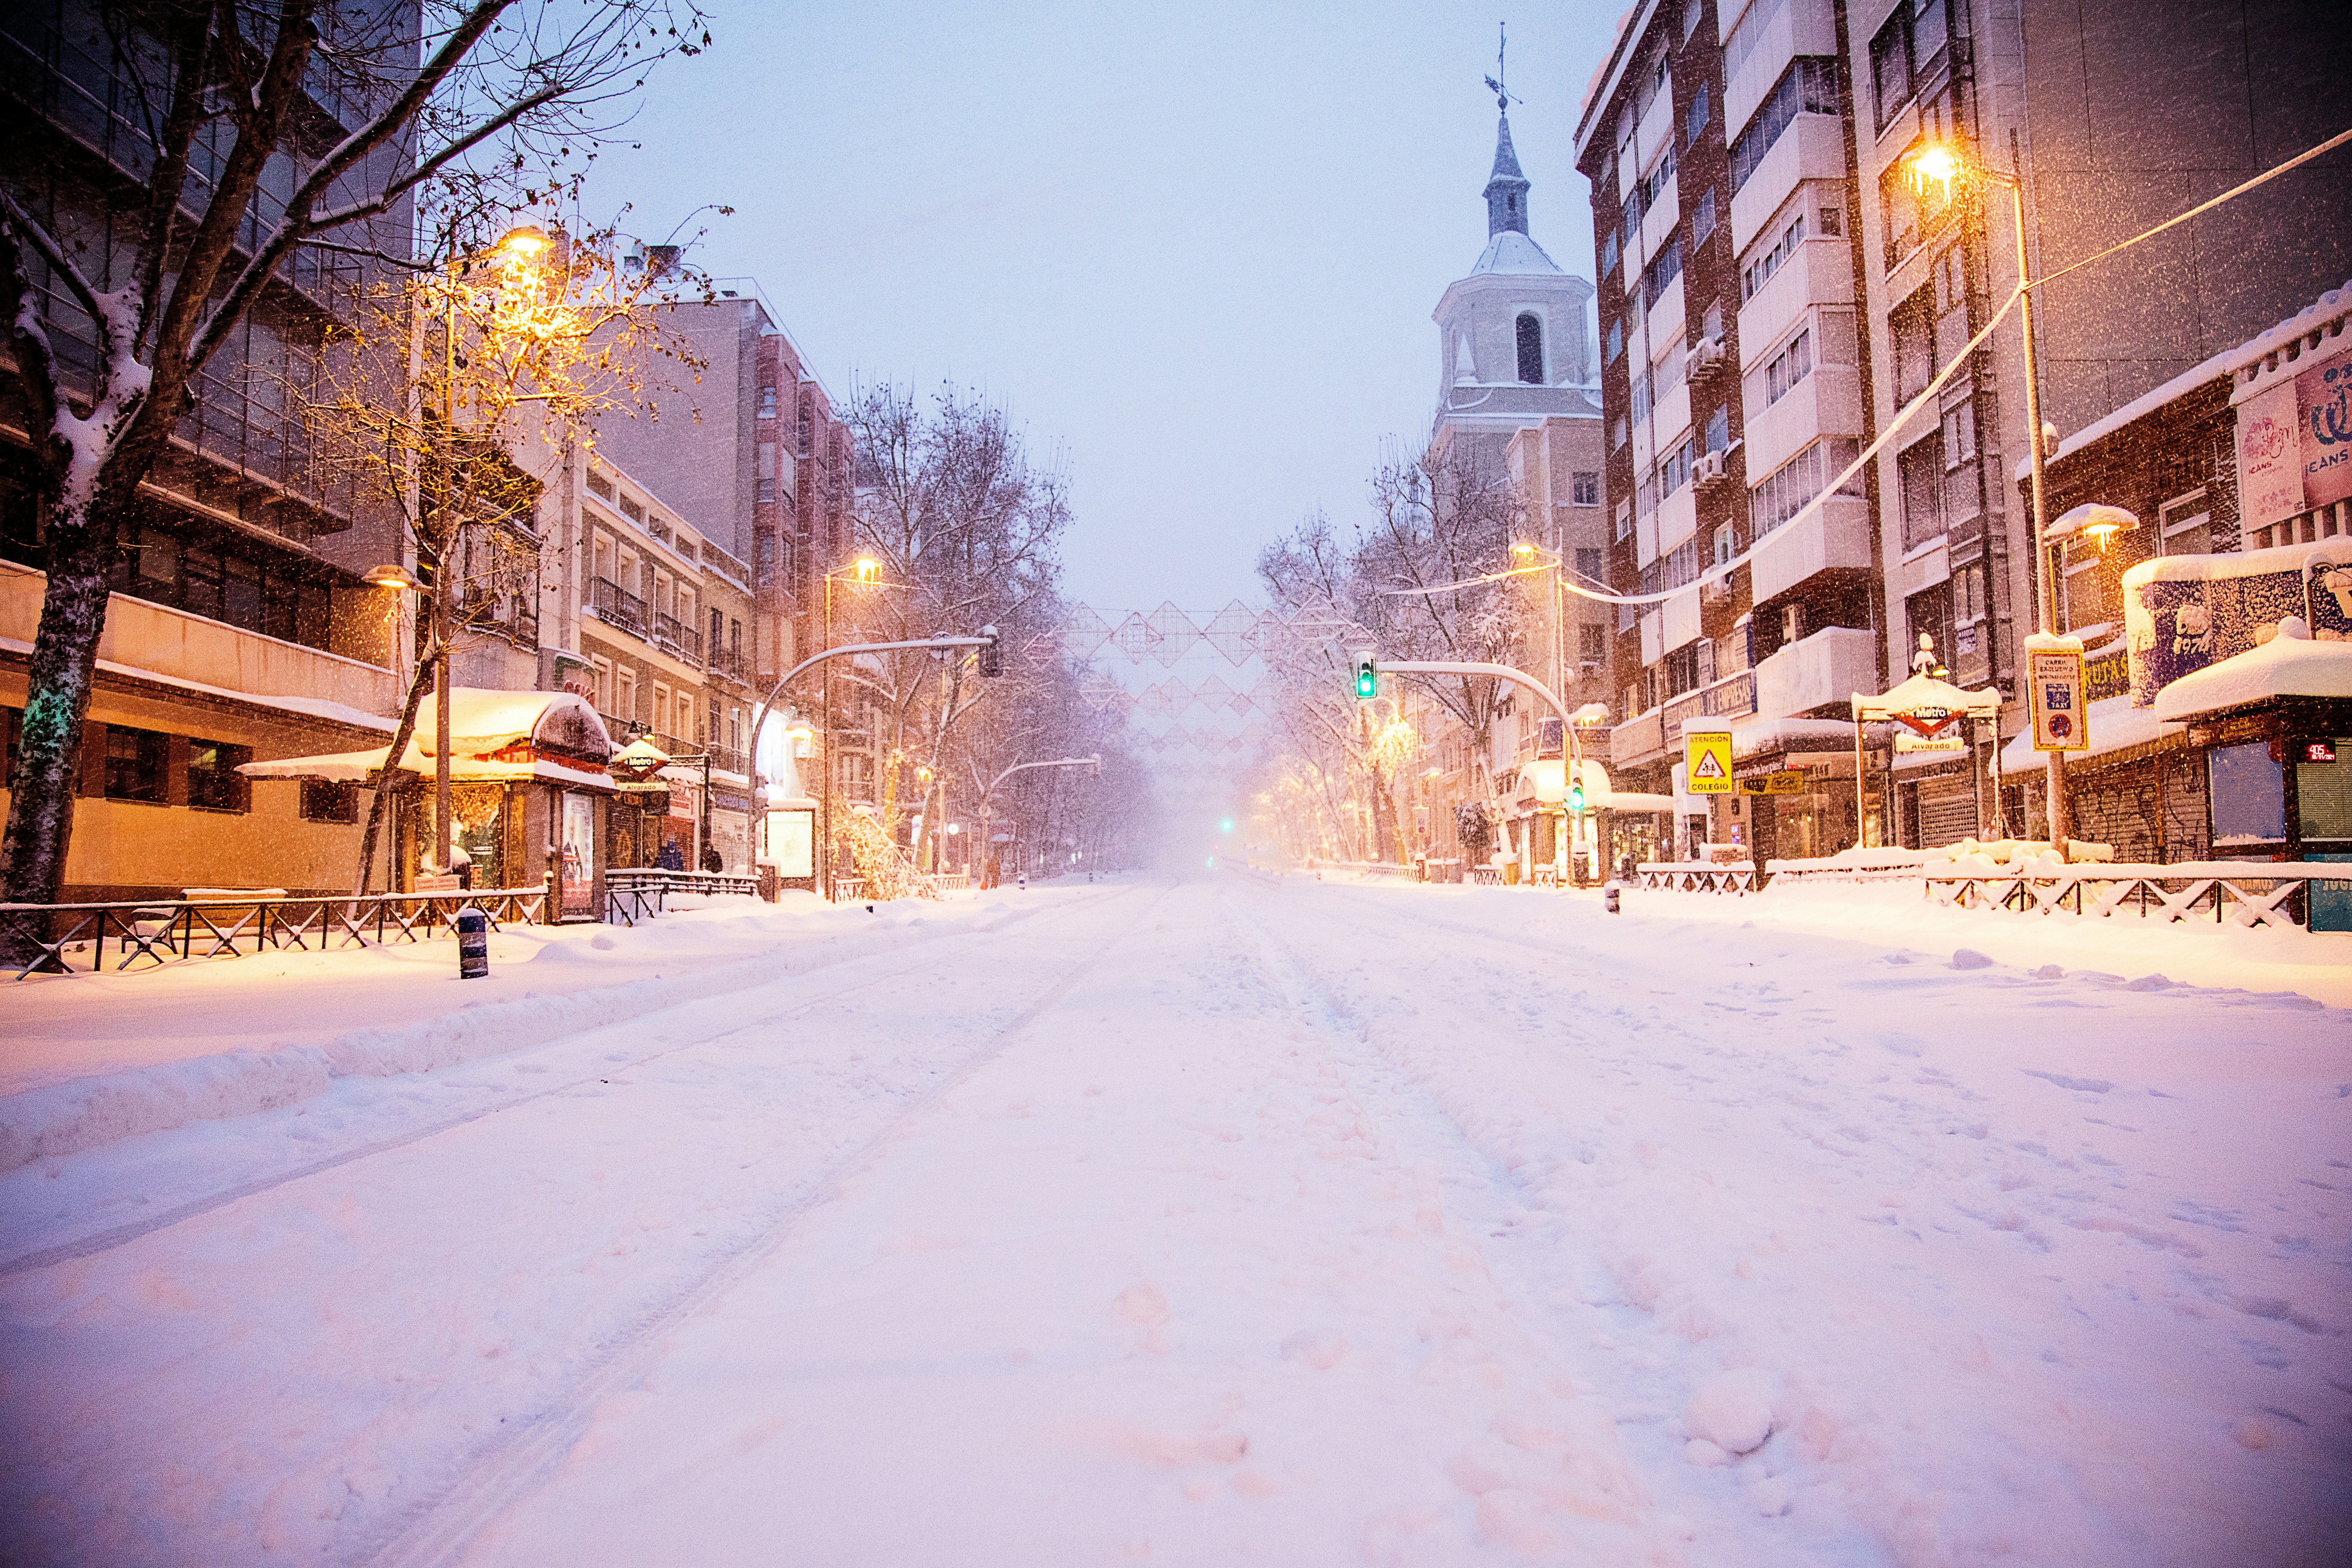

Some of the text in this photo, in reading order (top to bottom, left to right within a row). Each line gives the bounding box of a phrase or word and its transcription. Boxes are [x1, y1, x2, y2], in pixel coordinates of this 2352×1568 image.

[2248, 461, 2272, 475] JEANS
[2305, 449, 2348, 478] JEANS
[2173, 636, 2211, 655] 1974
[2085, 656, 2128, 687] RUTAS
[1917, 708, 1946, 718] Metro
[1689, 735, 1728, 744] ATENCIÓN
[2323, 880, 2352, 891] JUG
